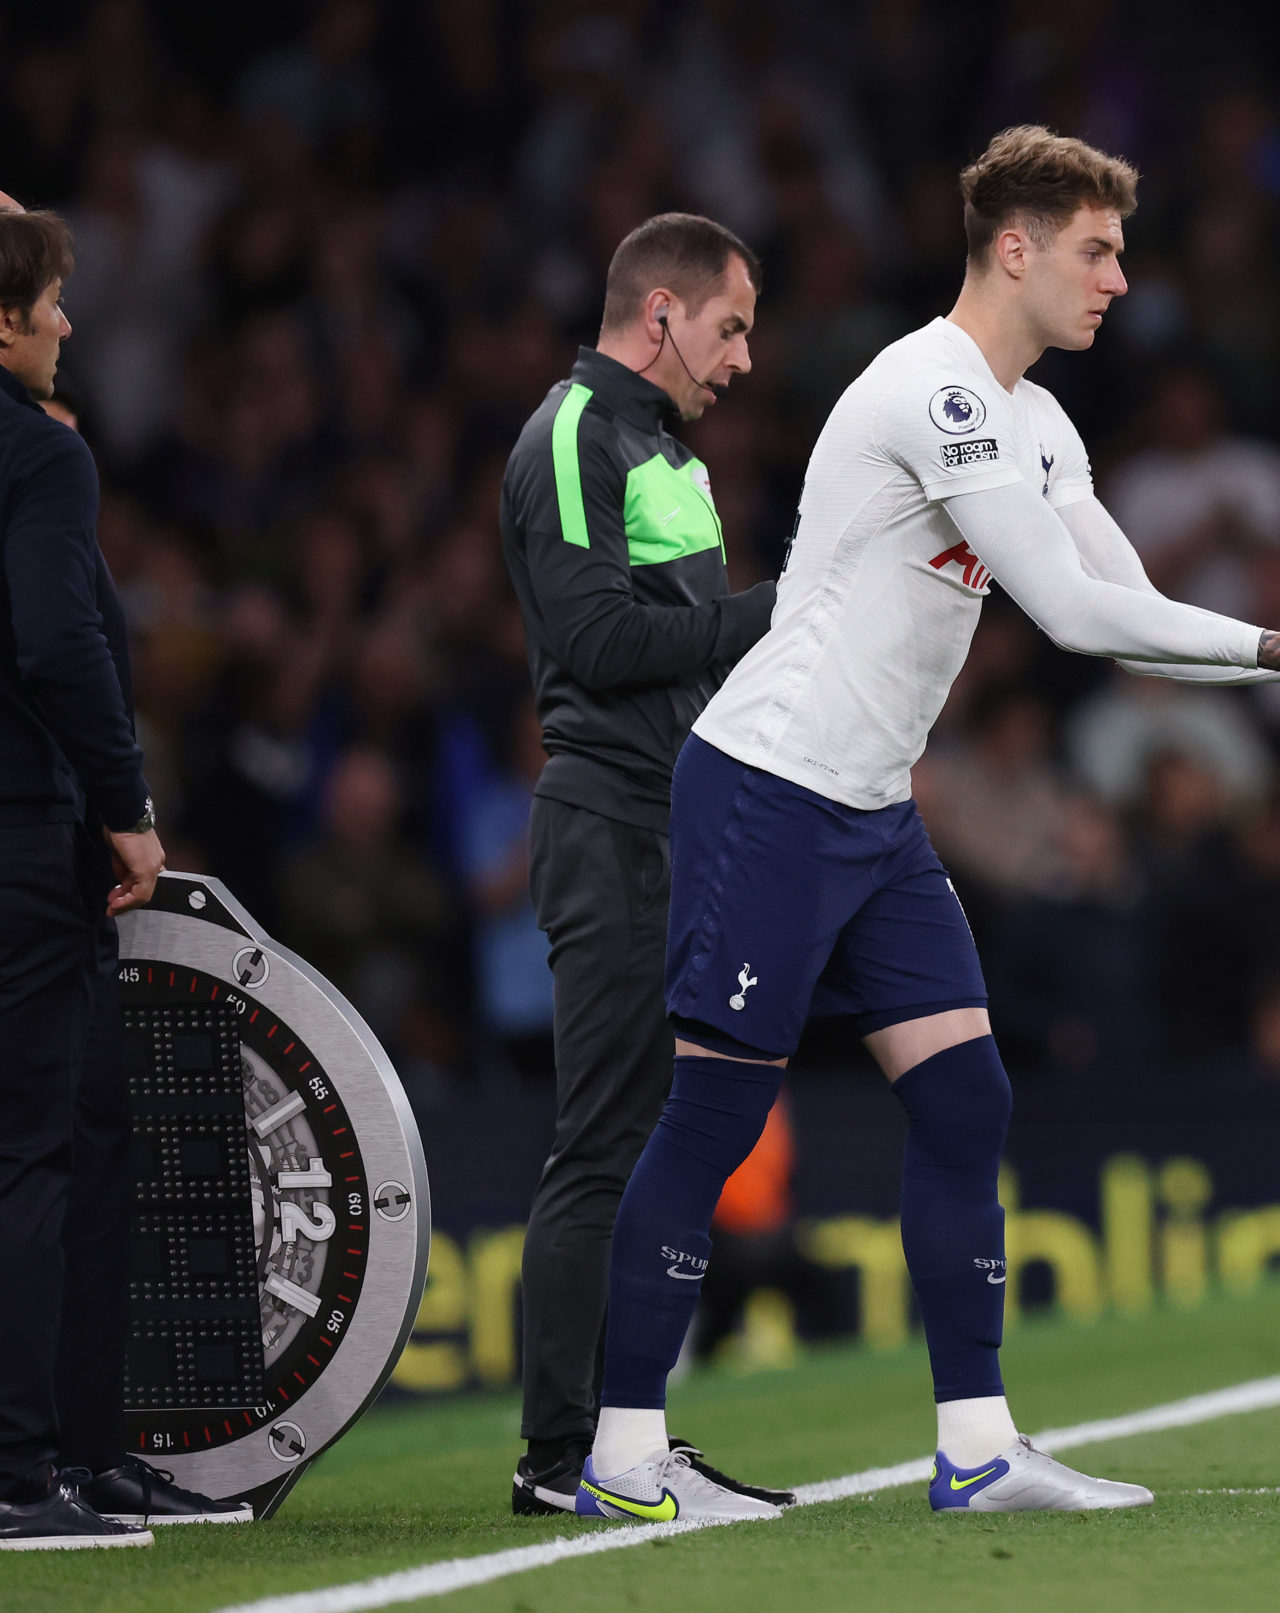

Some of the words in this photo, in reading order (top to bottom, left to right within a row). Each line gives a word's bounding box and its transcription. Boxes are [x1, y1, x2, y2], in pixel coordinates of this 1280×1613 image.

[940, 445, 959, 457] No
[960, 441, 993, 454] room
[943, 455, 960, 467] for
[961, 450, 999, 464] racism
[118, 967, 140, 983] 45
[308, 1076, 329, 1100] 55
[277, 1157, 336, 1242] 12
[347, 1192, 363, 1216] 60
[326, 1309, 345, 1334] 05
[152, 1432, 174, 1448] 15
